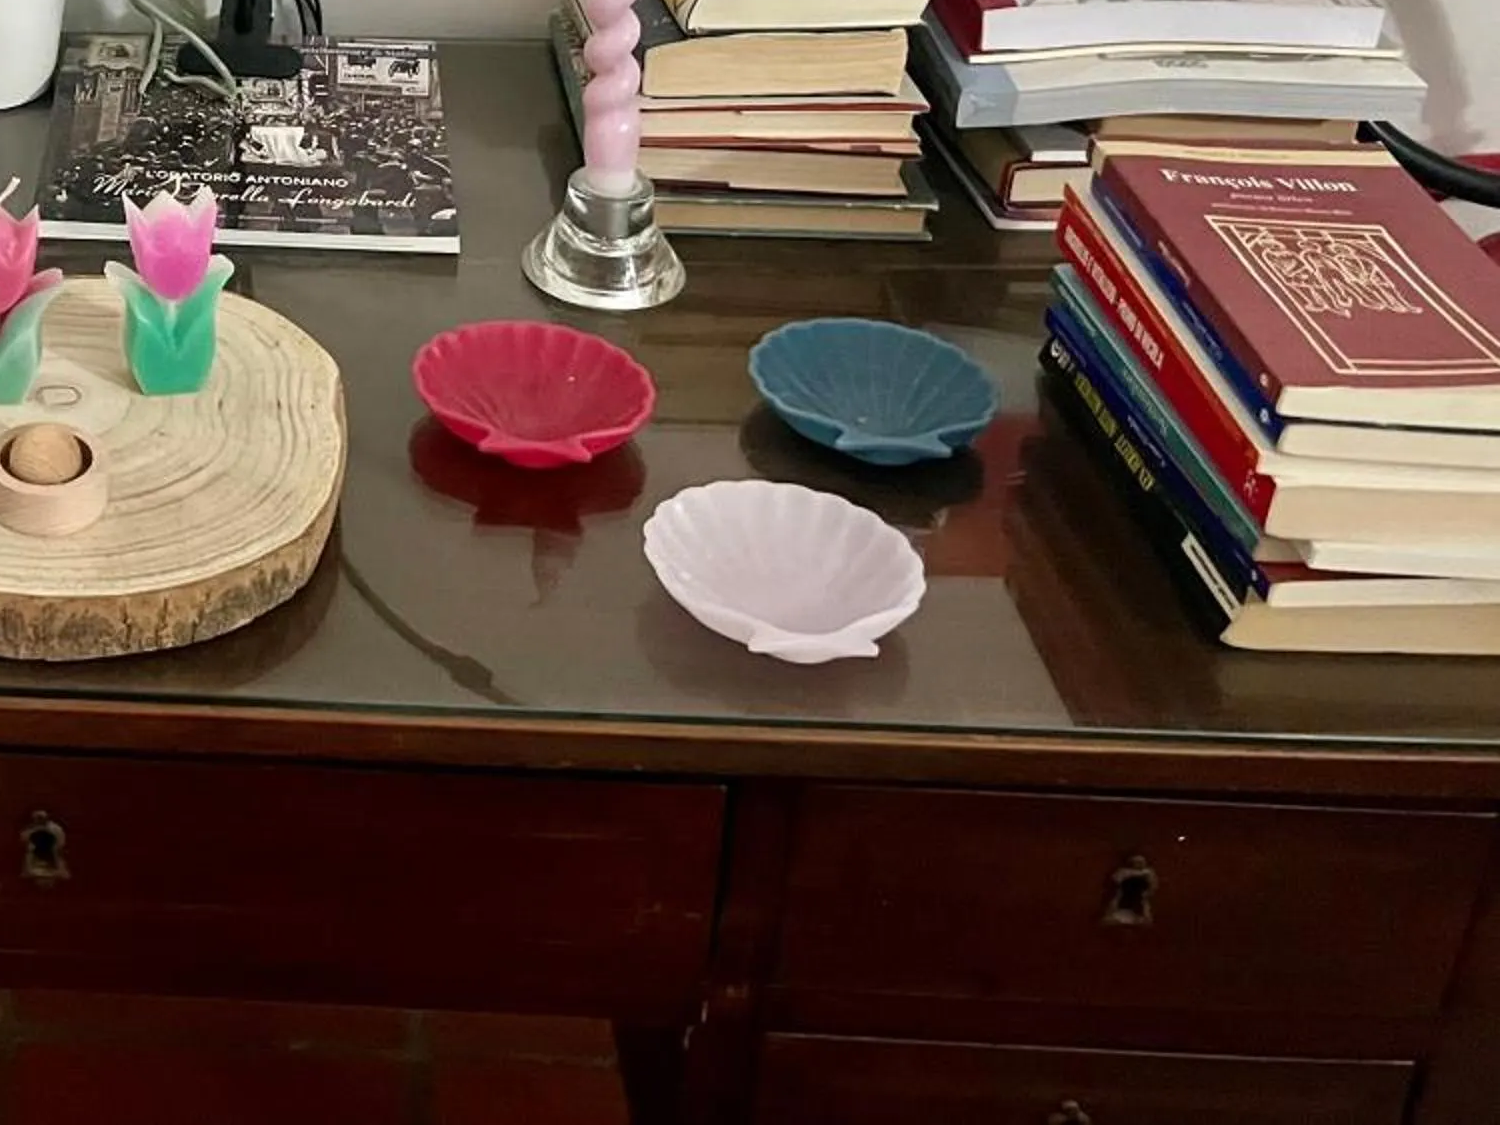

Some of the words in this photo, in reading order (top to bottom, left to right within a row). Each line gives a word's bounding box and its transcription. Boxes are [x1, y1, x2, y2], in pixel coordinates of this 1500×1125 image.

[245, 175, 349, 188] ANTONIANO
[1159, 168, 1274, 190] François
[1274, 177, 1358, 192] Villon
[277, 187, 417, 210] Longobardi
